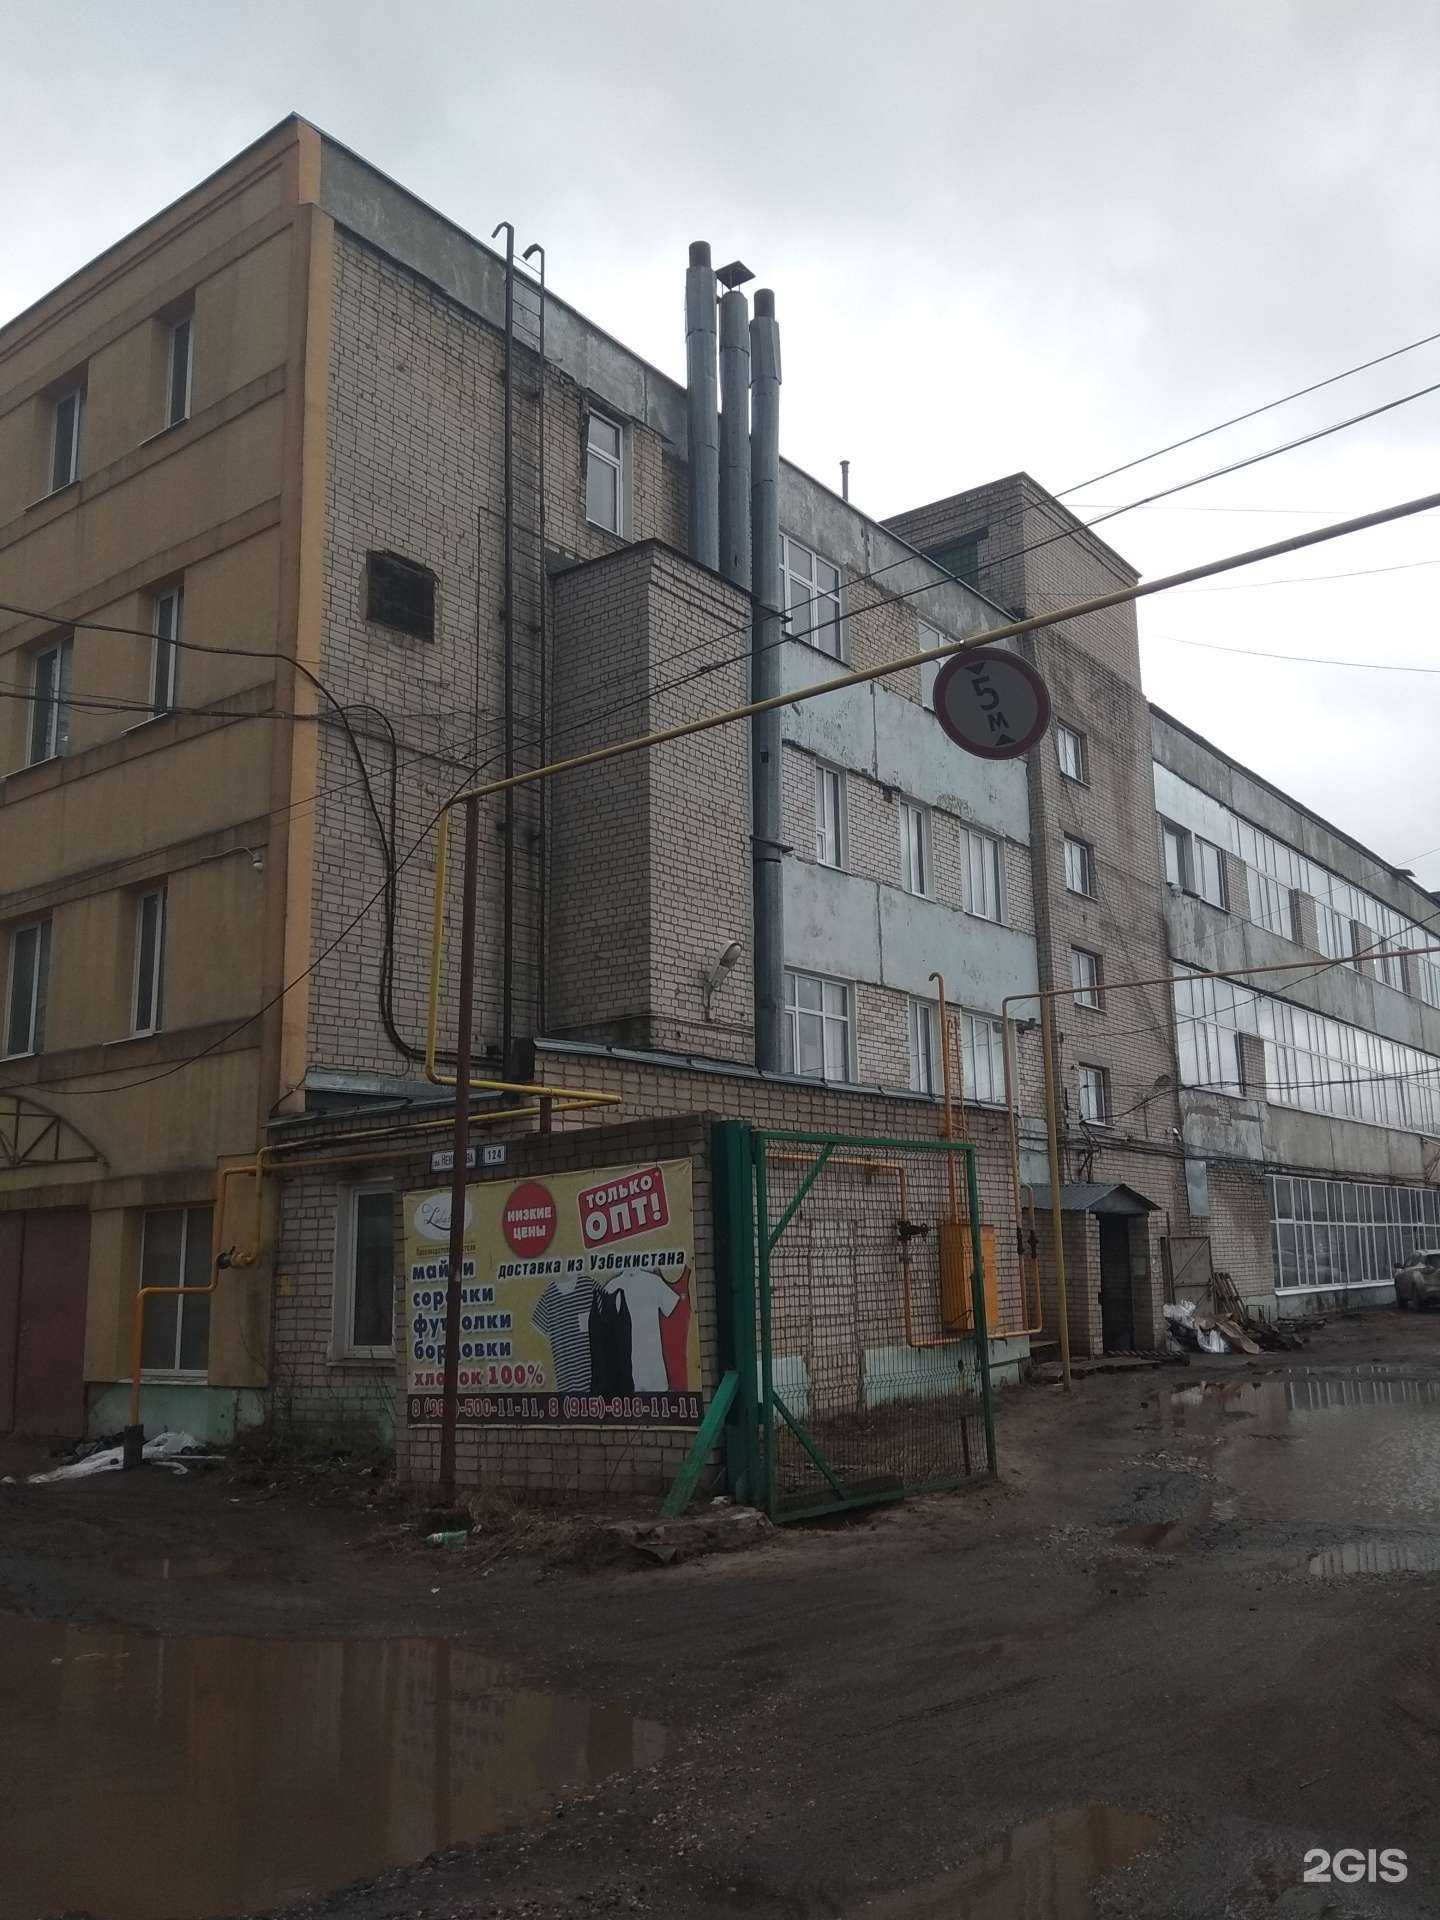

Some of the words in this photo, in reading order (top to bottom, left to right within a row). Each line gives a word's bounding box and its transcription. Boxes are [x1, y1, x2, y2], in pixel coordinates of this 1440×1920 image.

[971, 675, 1000, 711] 5
[488, 1149, 502, 1161] 124
[585, 1175, 653, 1209] ТОЛЬКО
[507, 1206, 552, 1222] НИЗКИЕ
[585, 1192, 663, 1241] ОПТ!
[513, 1225, 546, 1241] ЦЕНЫ
[412, 1259, 474, 1280] майи
[497, 1260, 561, 1280] доставка
[567, 1258, 584, 1273] из
[590, 1251, 685, 1271] Узбекистана
[413, 1312, 511, 1339] футолки
[413, 1340, 511, 1365] боровки
[414, 1371, 482, 1386] хлоок
[488, 1364, 543, 1385] 100%
[411, 1398, 421, 1418] 8
[548, 1397, 559, 1418] 8
